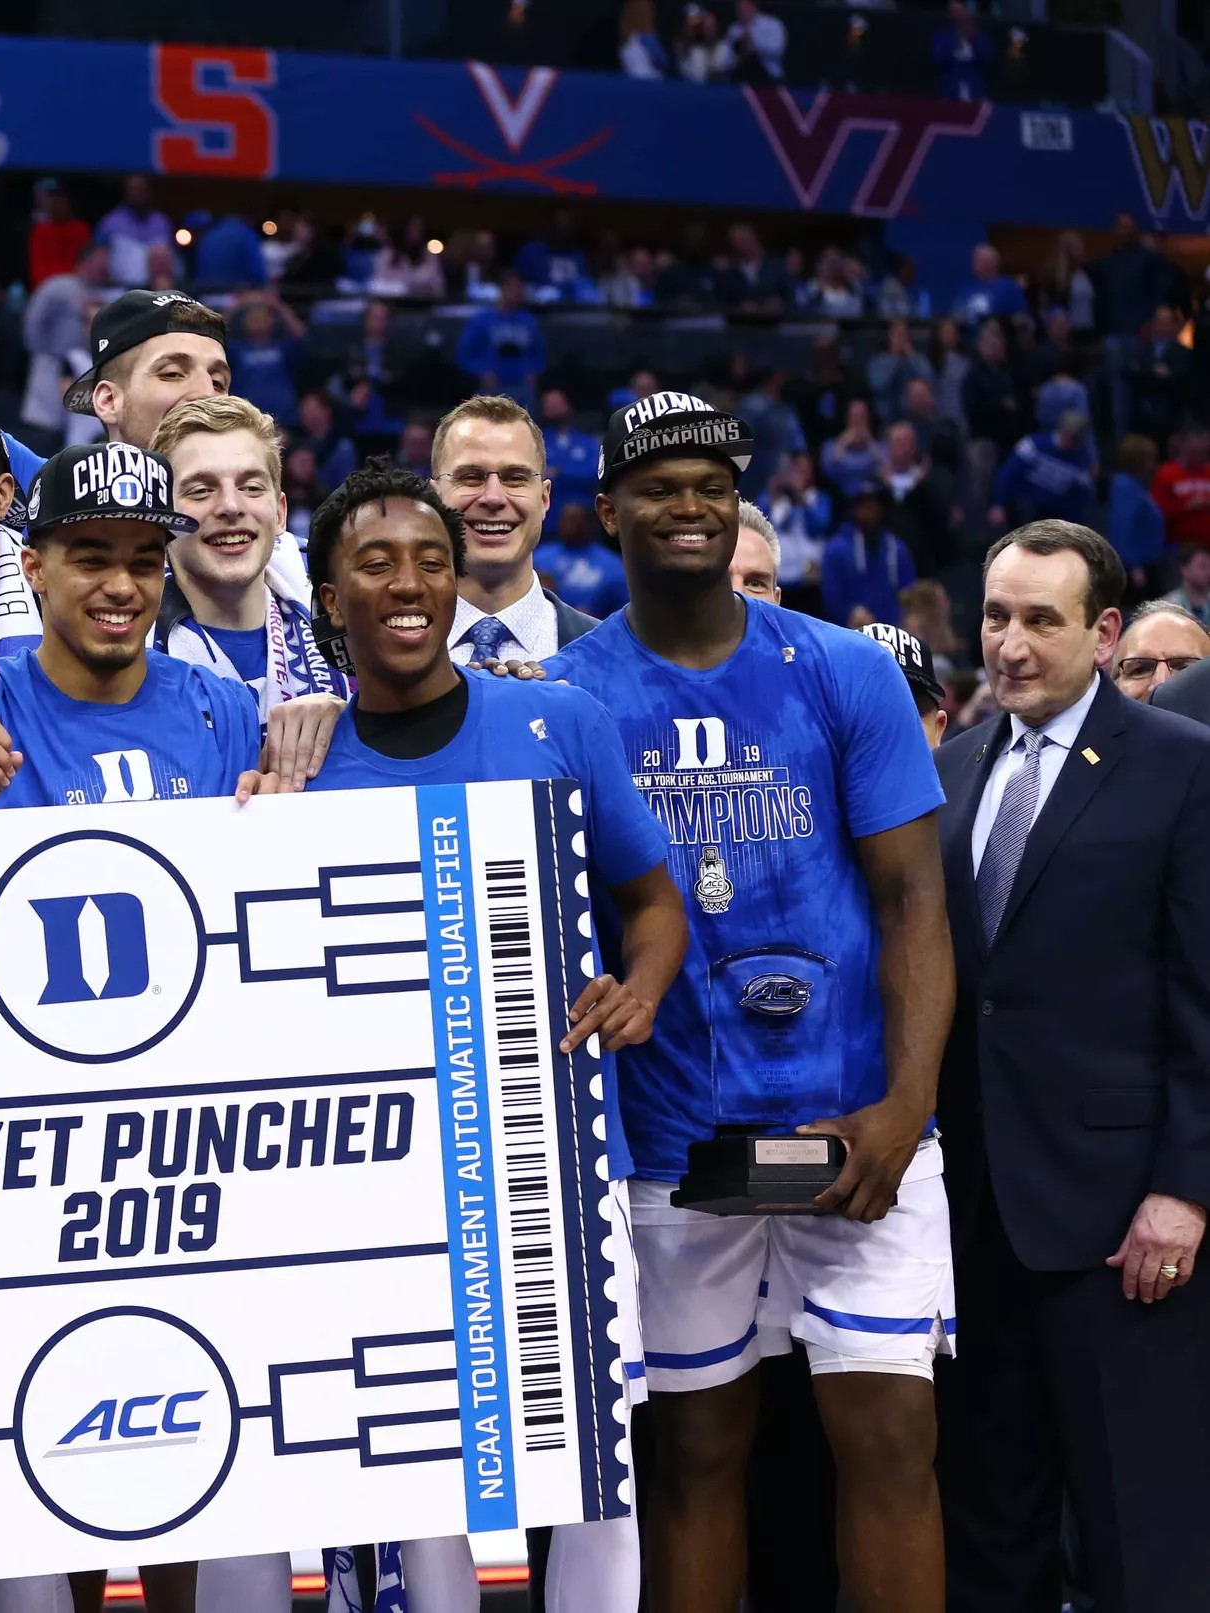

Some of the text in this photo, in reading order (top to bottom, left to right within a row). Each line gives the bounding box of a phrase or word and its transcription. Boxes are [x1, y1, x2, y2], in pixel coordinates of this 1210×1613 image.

[624, 422, 740, 460] CHAMPIONS
[73, 449, 168, 506] CHAMPS
[97, 489, 110, 506] 20
[145, 491, 153, 508] 19
[898, 653, 907, 667] 19
[643, 750, 661, 767] 20
[673, 717, 727, 769] D
[743, 745, 760, 762] 19
[91, 749, 155, 803] D
[170, 777, 188, 795] 19
[654, 775, 676, 787] YORK
[678, 774, 695, 786] LIFE
[717, 769, 774, 784] TOURNAMENT
[66, 789, 86, 805] 20
[27, 892, 150, 1005] D
[101, 1091, 415, 1182] PUNCHED
[432, 816, 504, 1499] NCAA TOURNAMENT AUTOMATIC QUALIFIER
[58, 1181, 222, 1262] 2019
[54, 1390, 210, 1446] ACC
